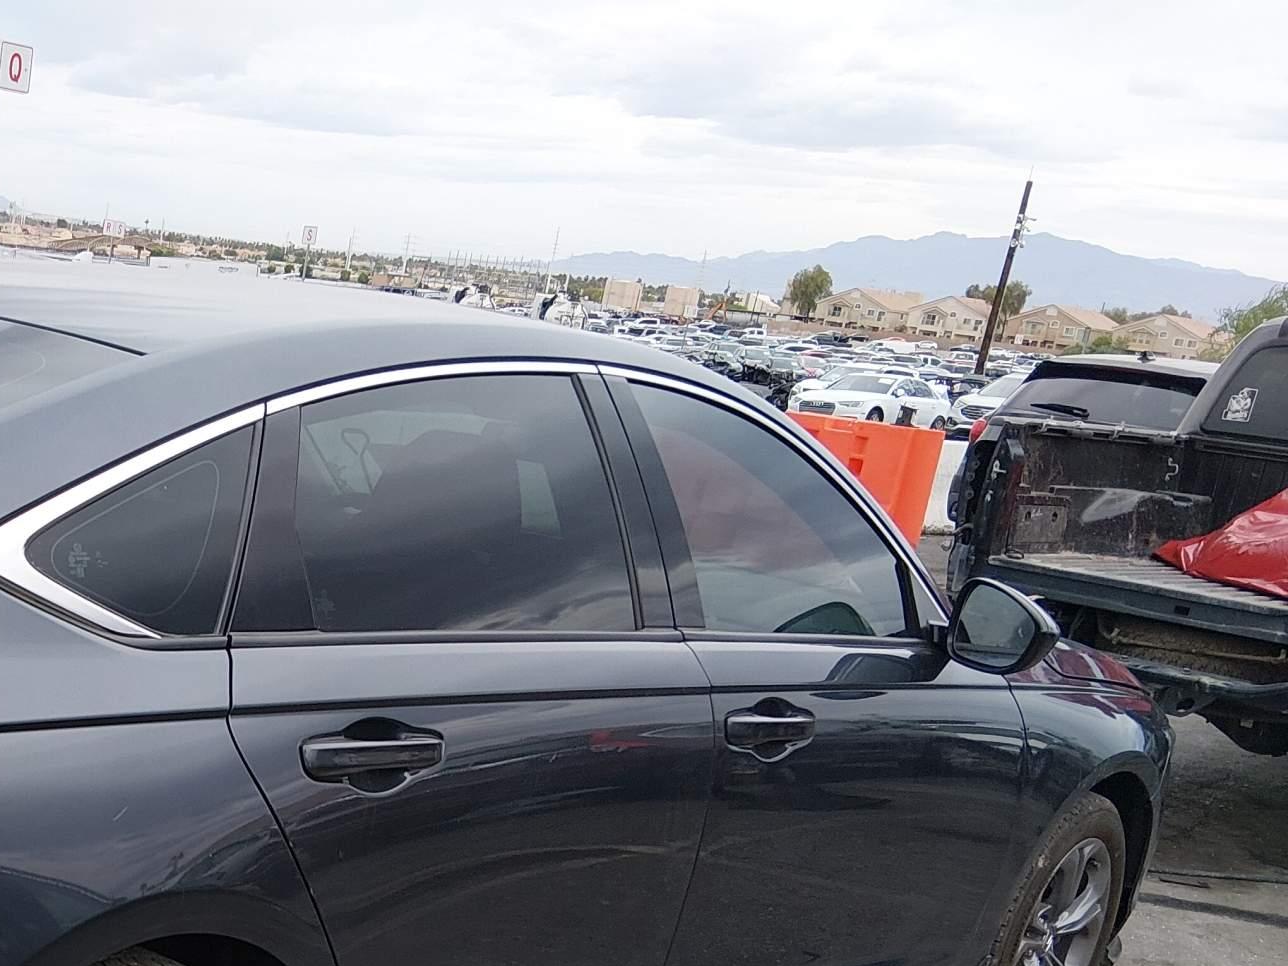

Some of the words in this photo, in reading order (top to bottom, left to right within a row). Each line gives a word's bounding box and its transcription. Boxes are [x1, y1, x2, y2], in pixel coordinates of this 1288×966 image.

[8, 52, 23, 83] Q
[106, 222, 112, 233] R
[117, 224, 123, 235] S
[306, 228, 313, 241] S
